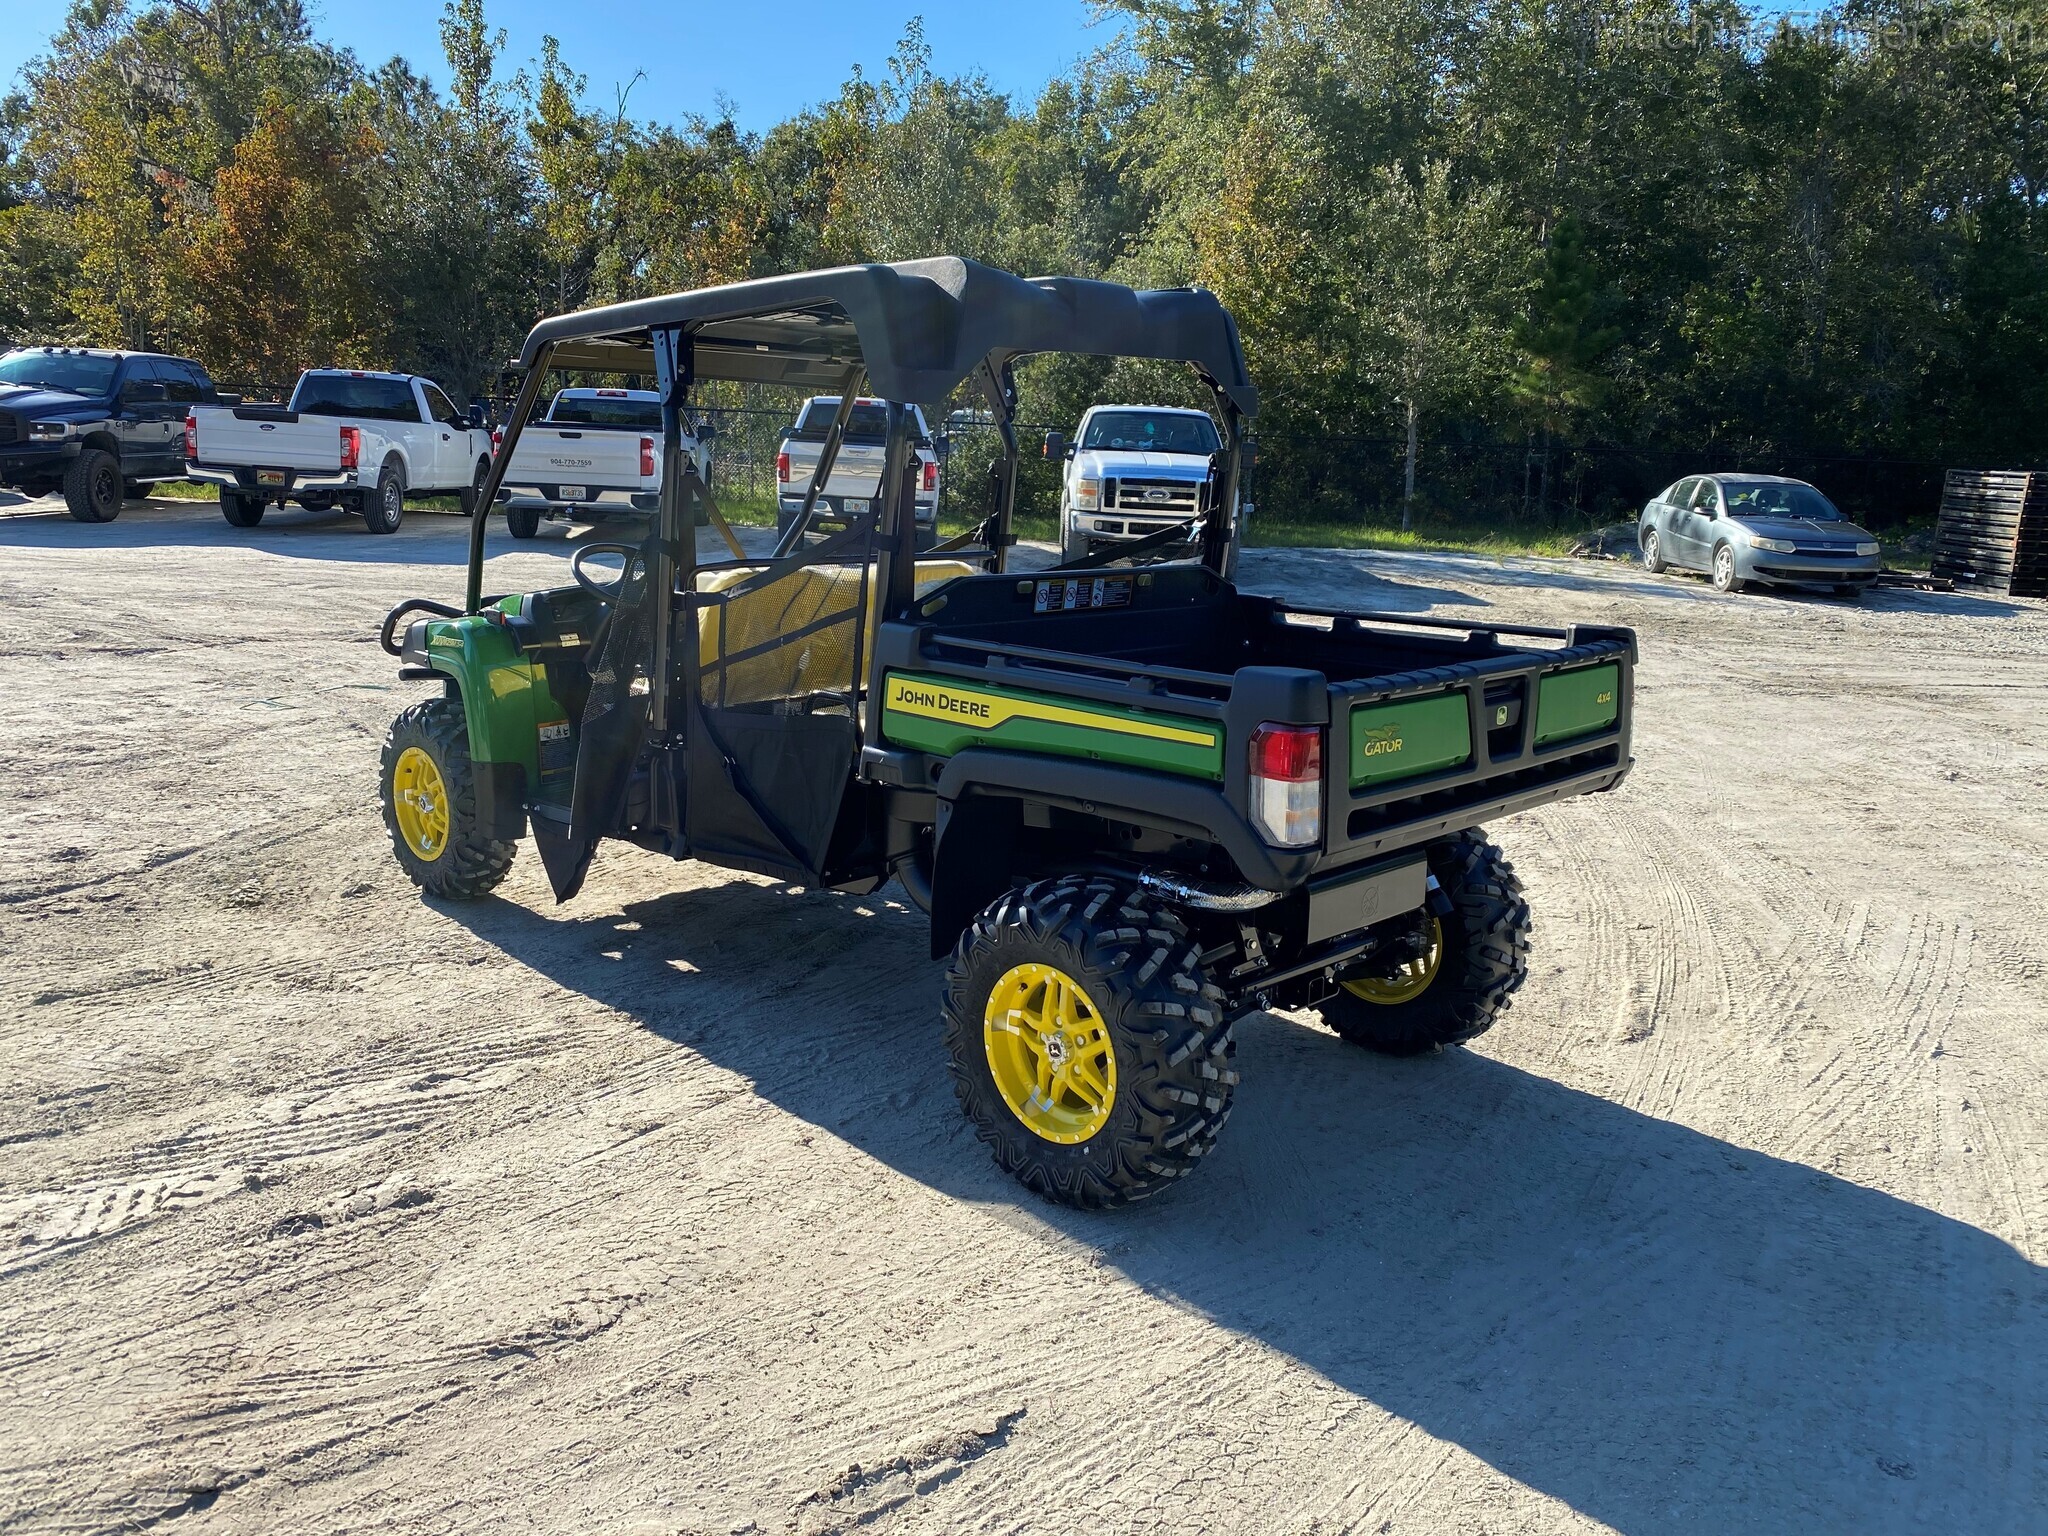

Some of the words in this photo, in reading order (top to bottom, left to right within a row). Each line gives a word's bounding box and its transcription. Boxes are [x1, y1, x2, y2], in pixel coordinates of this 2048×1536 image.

[895, 686, 935, 708] JOHN
[938, 693, 990, 719] DEERE
[1364, 738, 1403, 756] GATOR
